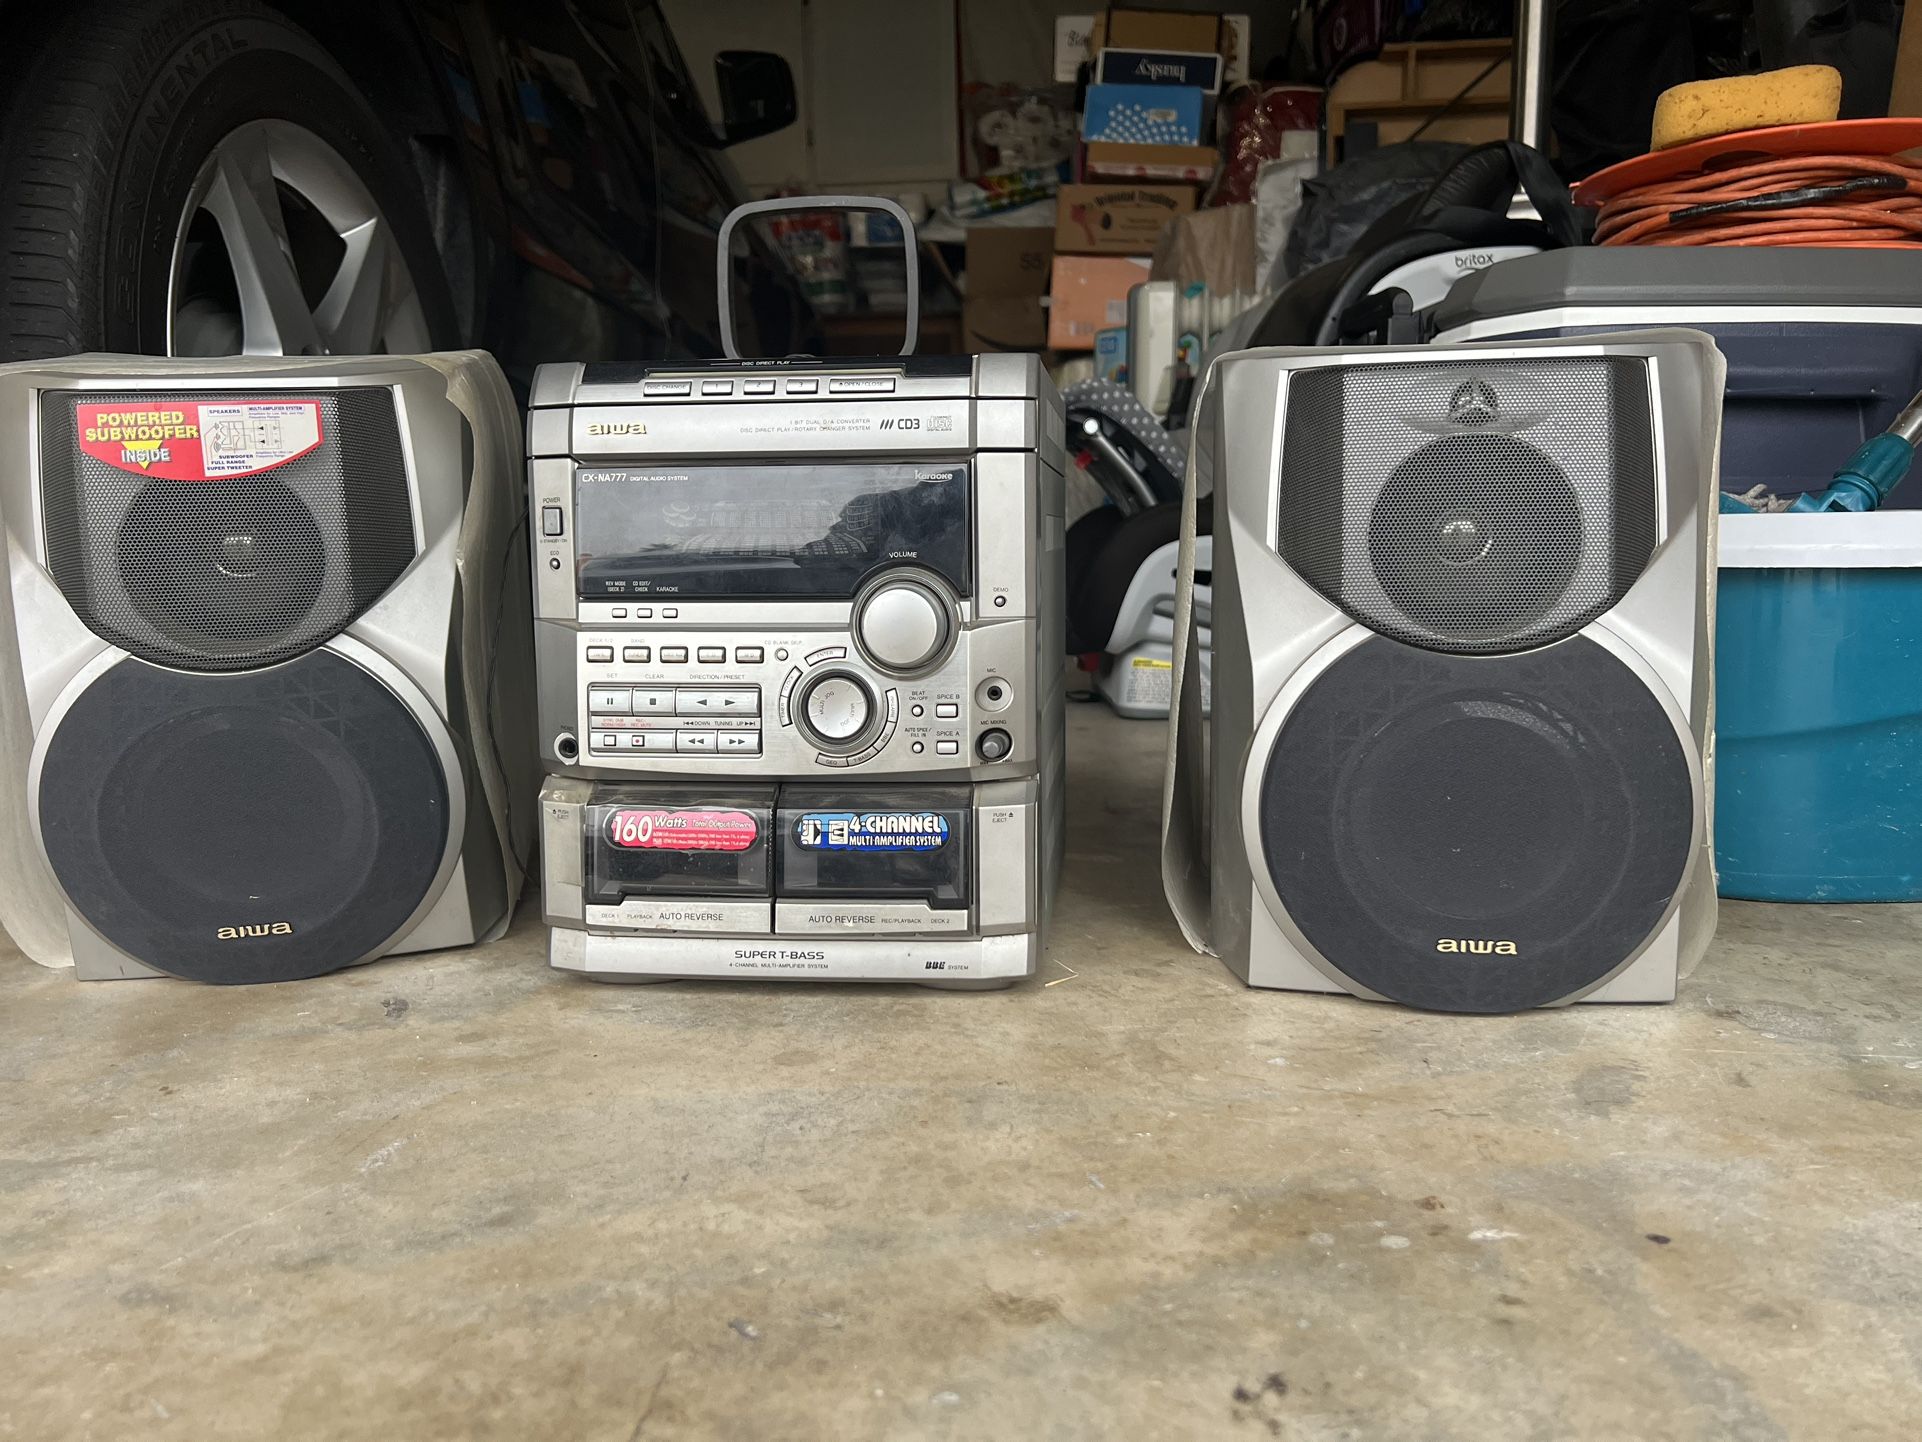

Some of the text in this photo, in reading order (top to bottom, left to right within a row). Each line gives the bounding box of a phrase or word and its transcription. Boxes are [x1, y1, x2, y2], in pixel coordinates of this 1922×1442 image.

[1454, 253, 1494, 268] britax
[96, 411, 185, 427] POWERED
[897, 418, 920, 430] CD3
[85, 425, 200, 442] SUBWOOFER
[586, 422, 647, 435] aiwa
[121, 448, 172, 464] INSIDE
[581, 473, 627, 483] CX-NA777
[889, 551, 918, 559] VOLUME
[612, 815, 653, 843] 160
[654, 816, 688, 828] Watts
[848, 815, 942, 834] 4-CHANNEL
[848, 835, 942, 846] MULTI-AMPLIFIER SYSTEM
[658, 912, 724, 921] AUTO REVERSE
[808, 915, 876, 924] AUTO REVERSE
[217, 922, 293, 939] aiwa
[1436, 938, 1518, 955] aiwa
[734, 950, 825, 961] SUPER T-BASS
